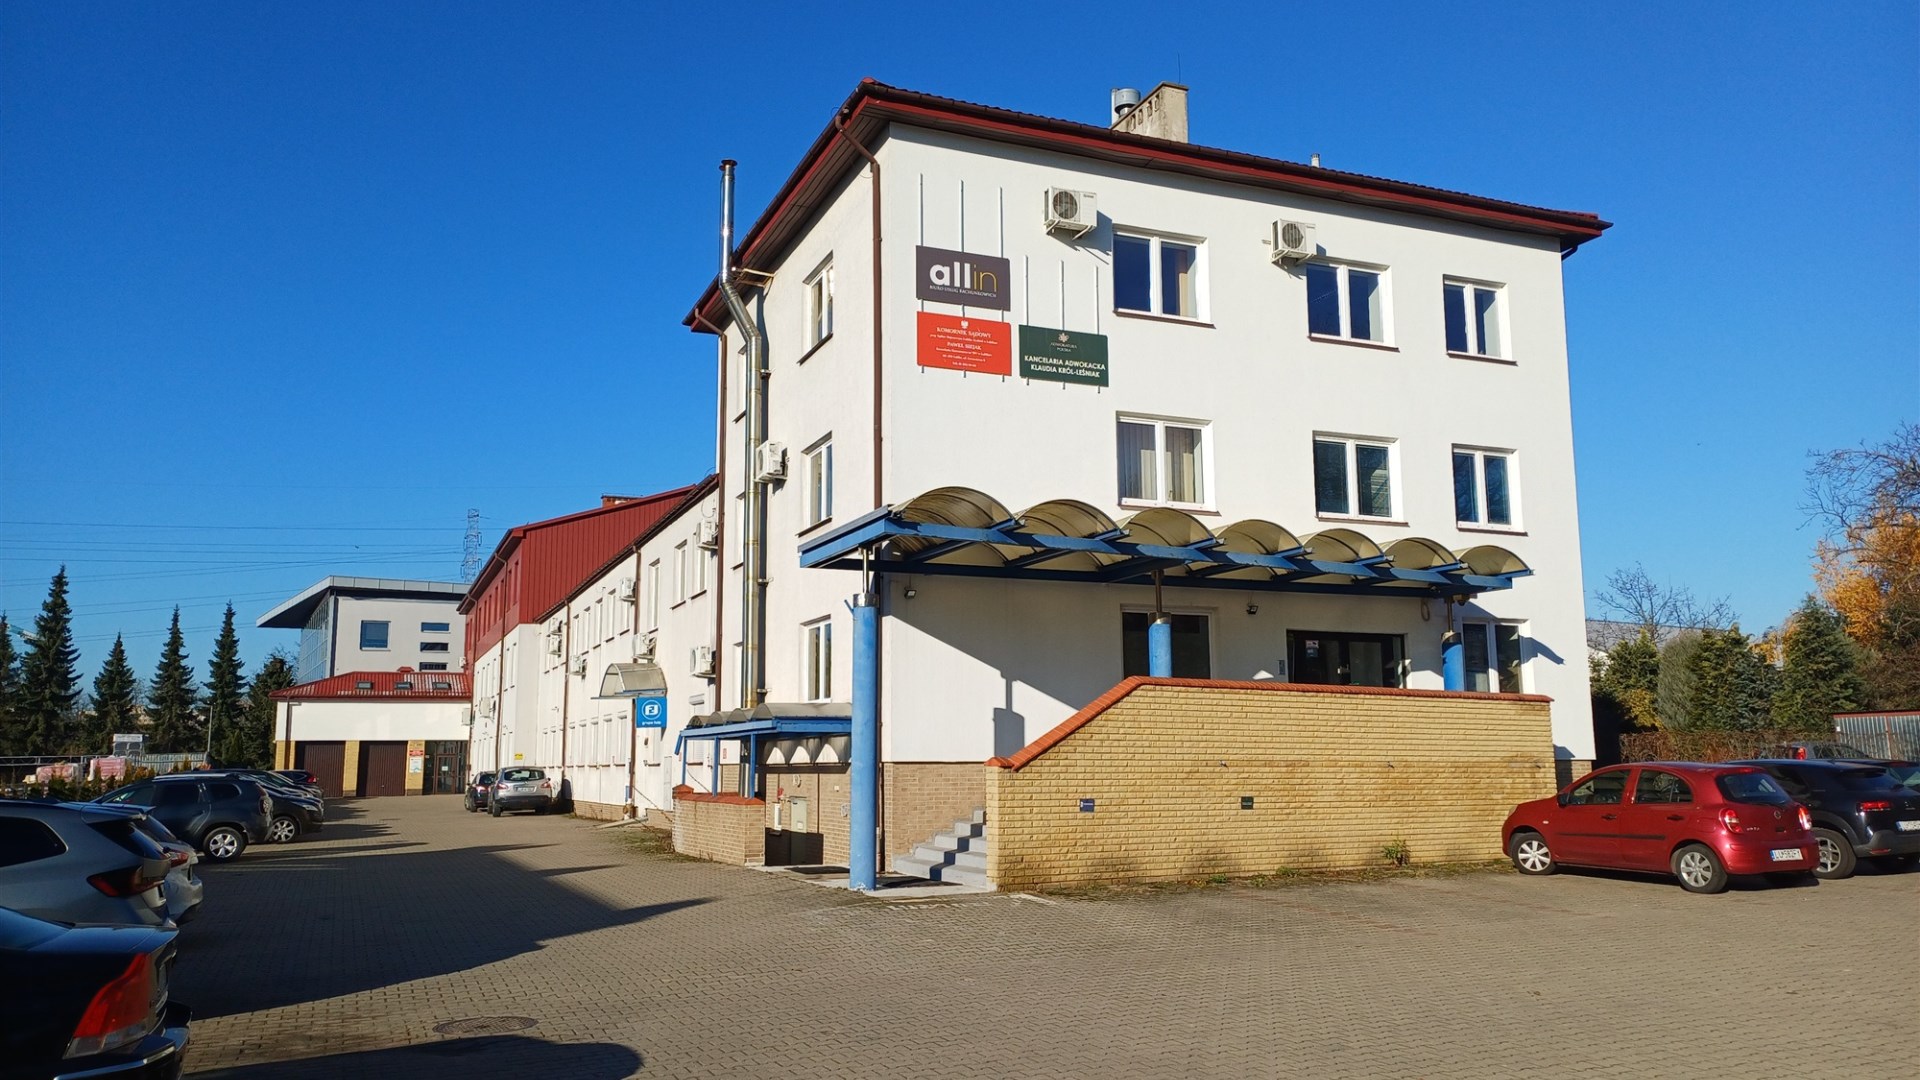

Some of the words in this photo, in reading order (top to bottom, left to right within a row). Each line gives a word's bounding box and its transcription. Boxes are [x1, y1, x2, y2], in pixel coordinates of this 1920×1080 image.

[1024, 355, 1063, 366] KANCELARIA
[1064, 359, 1106, 370] ADWOKACKA
[1030, 364, 1057, 373] KLAUDIA
[1058, 366, 1101, 378] KRÓL-LEŚNIAK
